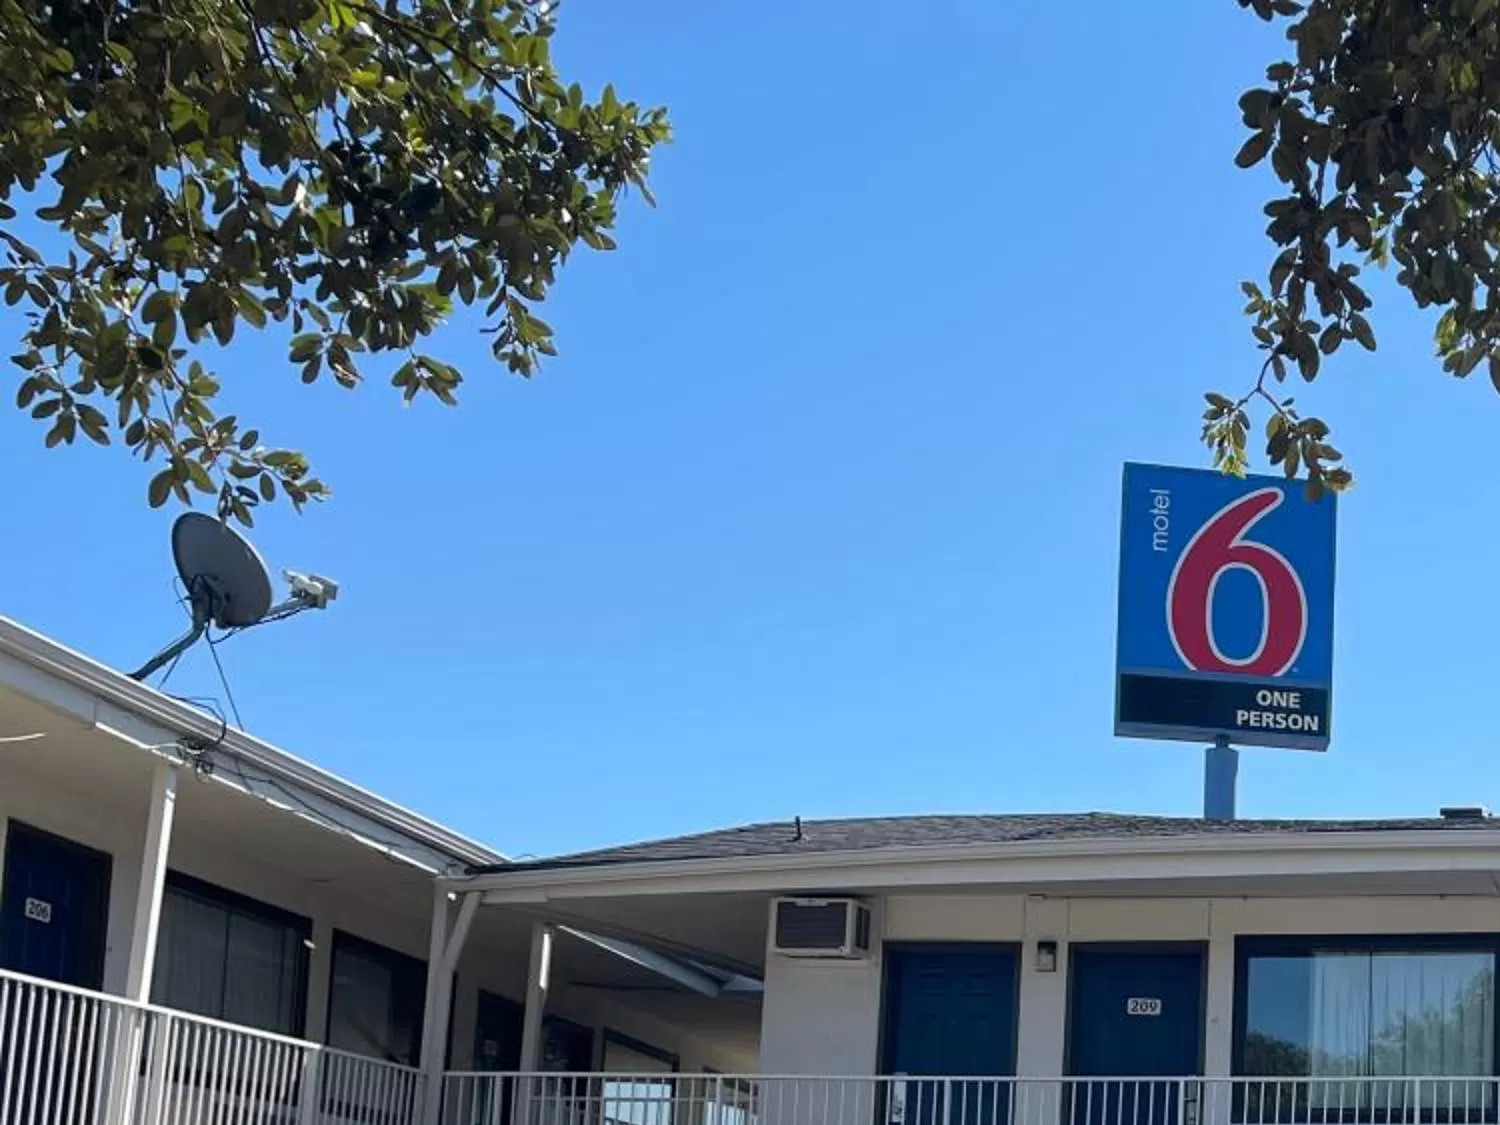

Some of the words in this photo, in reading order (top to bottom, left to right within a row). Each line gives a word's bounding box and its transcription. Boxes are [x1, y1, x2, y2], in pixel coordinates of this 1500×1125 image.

[1149, 488, 1171, 552] motel
[1165, 486, 1308, 677] 6
[1255, 689, 1302, 709] ONE
[1236, 709, 1320, 732] PERSON
[1130, 999, 1157, 1013] 209
